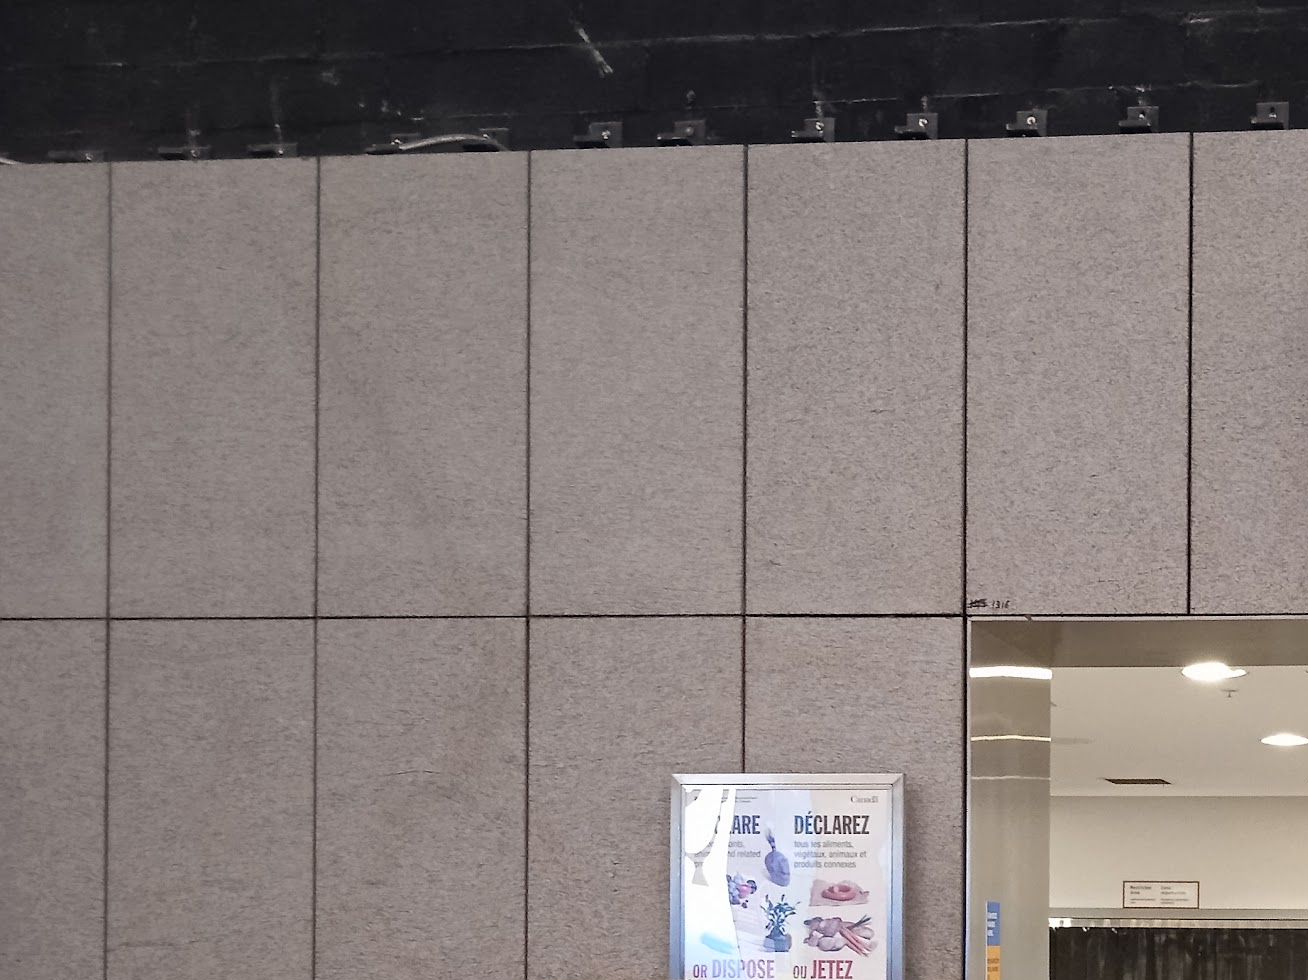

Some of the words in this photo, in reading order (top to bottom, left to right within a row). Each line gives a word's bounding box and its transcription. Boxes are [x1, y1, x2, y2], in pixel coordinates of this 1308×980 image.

[794, 811, 869, 834] DÉCLAREZ
[794, 861, 822, 869] produits
[693, 965, 708, 978] OR
[712, 959, 775, 979] DISPOSE
[793, 965, 807, 979] OU
[810, 960, 853, 979] JETEZ
